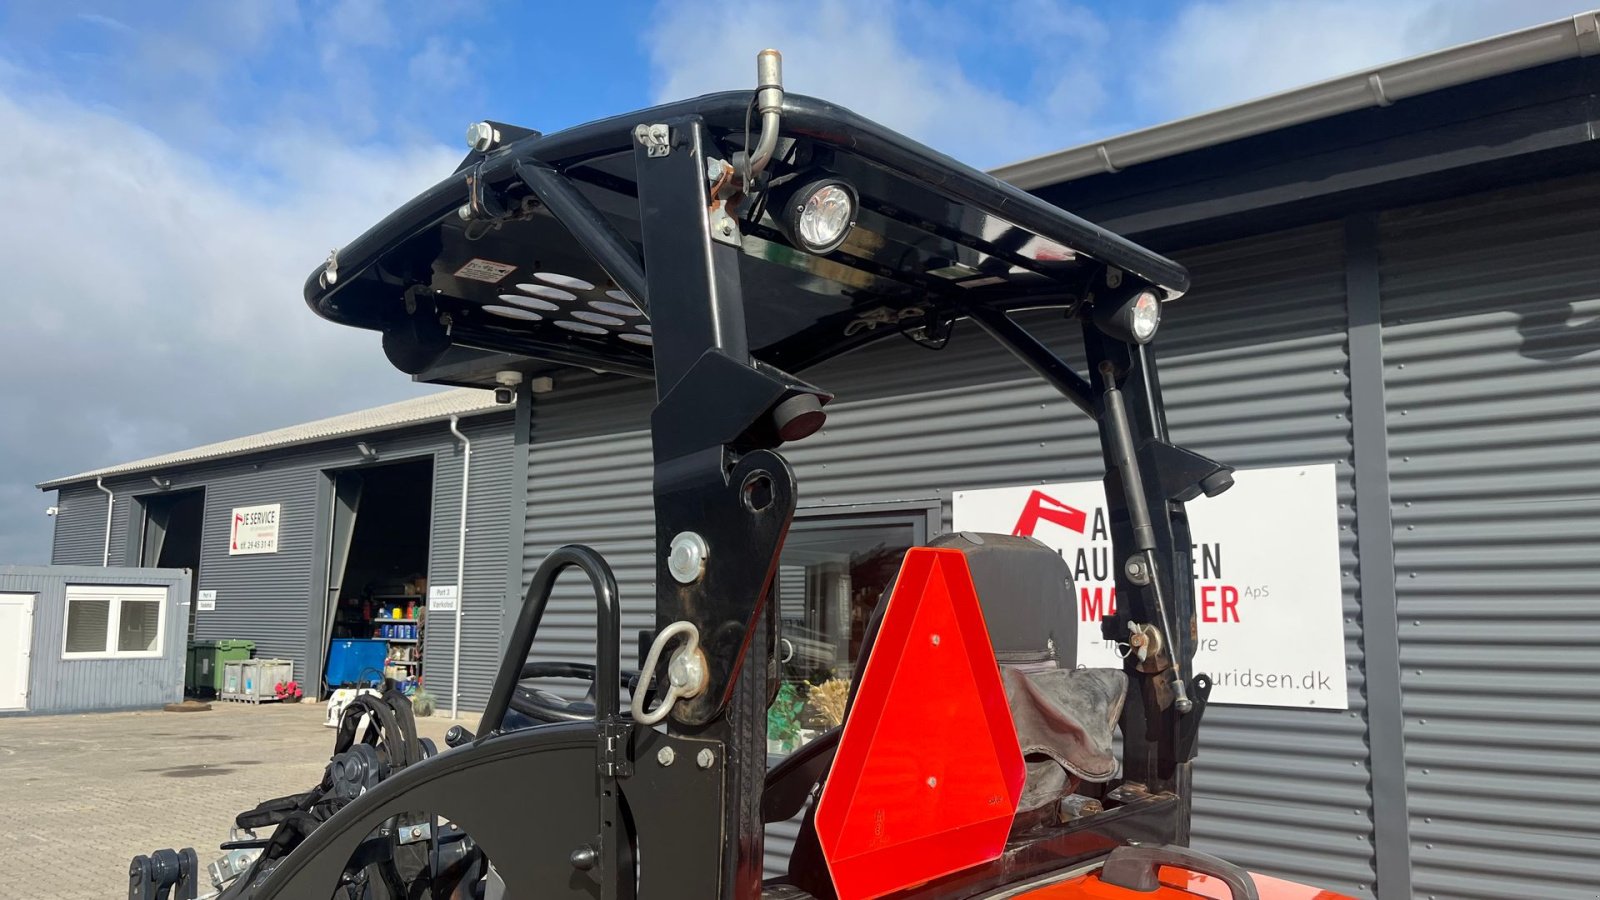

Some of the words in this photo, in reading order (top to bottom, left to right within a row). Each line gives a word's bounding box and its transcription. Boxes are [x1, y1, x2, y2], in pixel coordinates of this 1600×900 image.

[243, 513, 249, 525] JE
[250, 511, 275, 525] SERVICE
[1245, 585, 1270, 600] ApS
